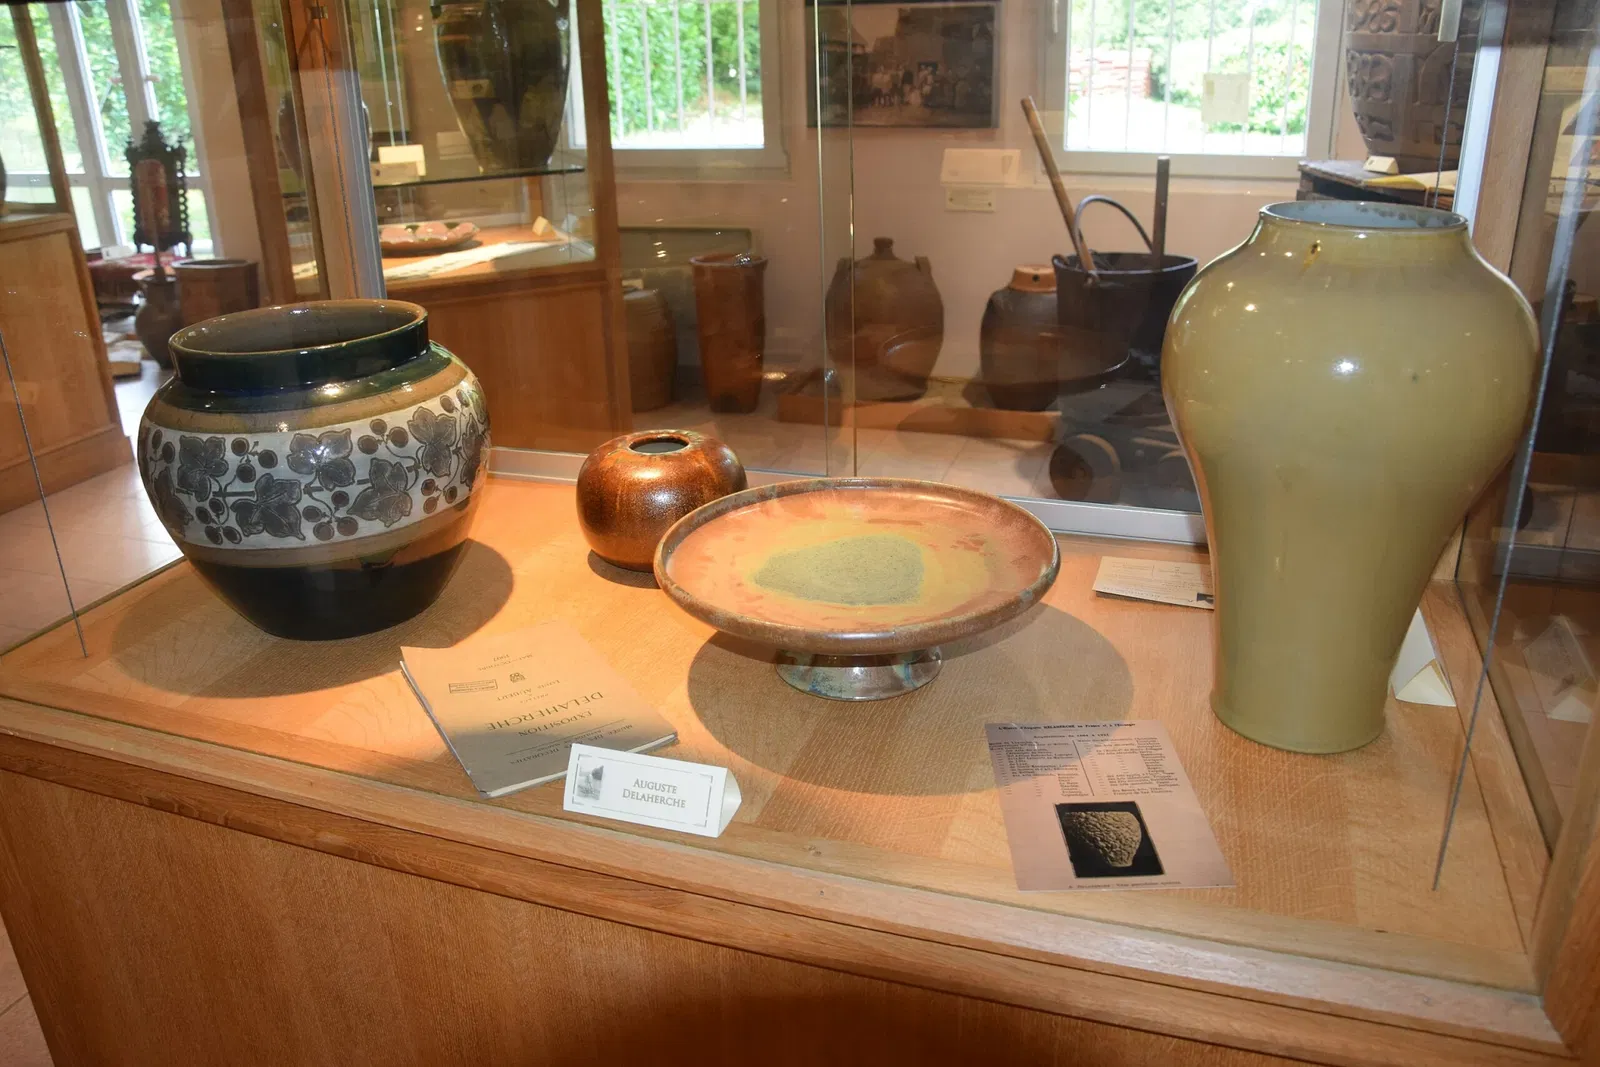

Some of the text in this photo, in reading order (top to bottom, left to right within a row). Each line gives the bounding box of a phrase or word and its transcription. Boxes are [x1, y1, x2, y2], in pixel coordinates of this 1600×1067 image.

[486, 691, 604, 731] DELAHERCHE
[517, 710, 593, 737] EXPOSITION
[622, 788, 687, 809] DELAHERCHE
[633, 778, 678, 795] AUGUSTE
